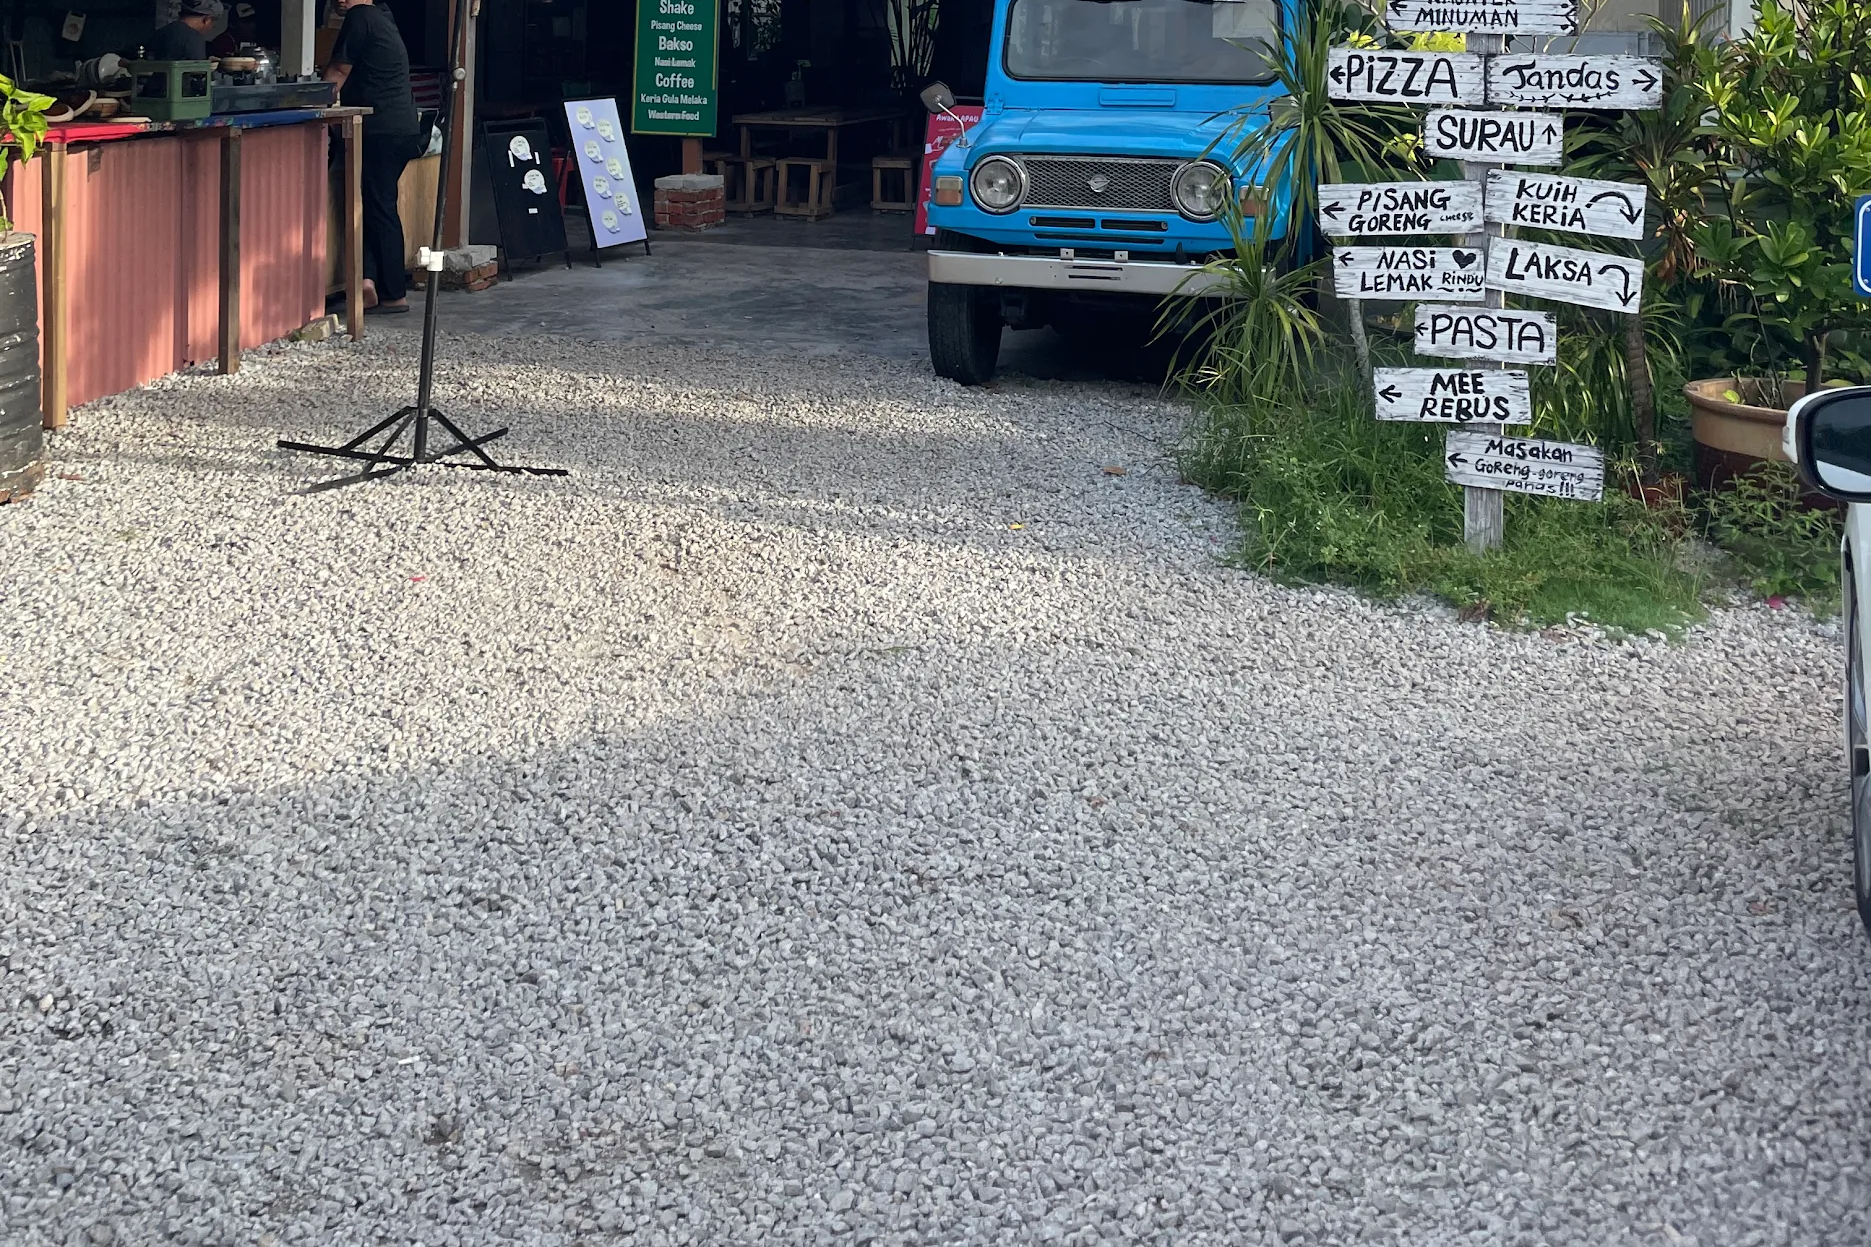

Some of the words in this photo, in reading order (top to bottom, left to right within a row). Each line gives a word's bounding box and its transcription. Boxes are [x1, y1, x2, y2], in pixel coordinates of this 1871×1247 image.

[651, 19, 675, 33] Pisang
[677, 20, 703, 31] Cheese
[1415, 7, 1519, 28] MINUMAN
[658, 35, 693, 51] Bakso
[654, 56, 671, 66] Nasi
[671, 56, 697, 68] Lemak
[655, 72, 695, 88] Coffee
[640, 93, 661, 103] Keria
[662, 93, 679, 104] Gula
[680, 94, 708, 105] Melaka
[681, 110, 700, 121] Food
[1436, 114, 1535, 153] SURAU
[1356, 187, 1452, 212] PISANG
[1348, 213, 1432, 233] GORENG
[1505, 247, 1592, 286] LAKSA
[1360, 271, 1433, 292] LEMAK
[1430, 313, 1545, 353] PASTA
[1429, 372, 1485, 397] MEE
[1420, 396, 1511, 422] REBUS
